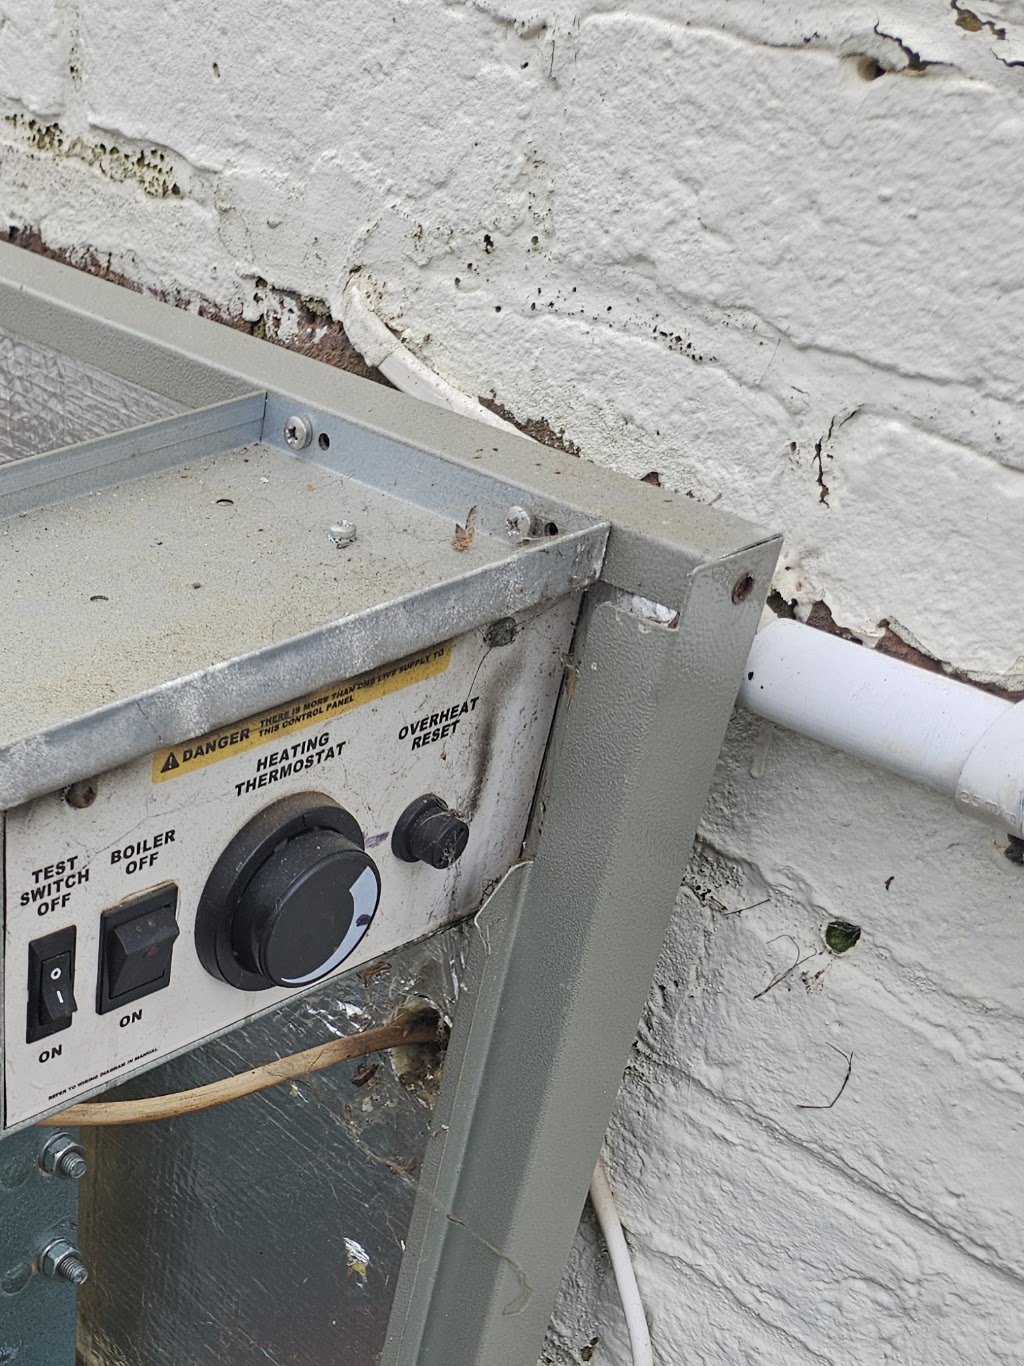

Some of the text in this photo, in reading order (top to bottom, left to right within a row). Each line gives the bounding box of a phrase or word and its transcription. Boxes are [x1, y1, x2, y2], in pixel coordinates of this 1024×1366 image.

[182, 728, 250, 763] DANGER
[259, 711, 290, 728] THERE
[292, 705, 301, 715] IS
[302, 695, 329, 711] MORE
[331, 685, 356, 700] THAN
[398, 655, 431, 674] SUPPLY
[433, 649, 444, 659] TO
[258, 695, 354, 737] THIS CONTROL PANEL
[398, 696, 479, 740] OVERHEAT
[256, 732, 330, 773] HEATING
[411, 720, 460, 751] RESET
[235, 741, 346, 797] THERMOSTAT
[110, 829, 176, 864] BOILER
[125, 851, 159, 875] OFF
[19, 868, 90, 907] SWITCH
[31, 855, 78, 884] TEST
[36, 892, 71, 916] OFF
[119, 1009, 143, 1028] ON
[38, 1044, 63, 1063] ON
[48, 1088, 67, 1101] REFER
[68, 1084, 77, 1092] TO
[77, 1074, 99, 1087] WIRING
[99, 1062, 126, 1077] DIAGRAM
[134, 1047, 158, 1061] MANUAL
